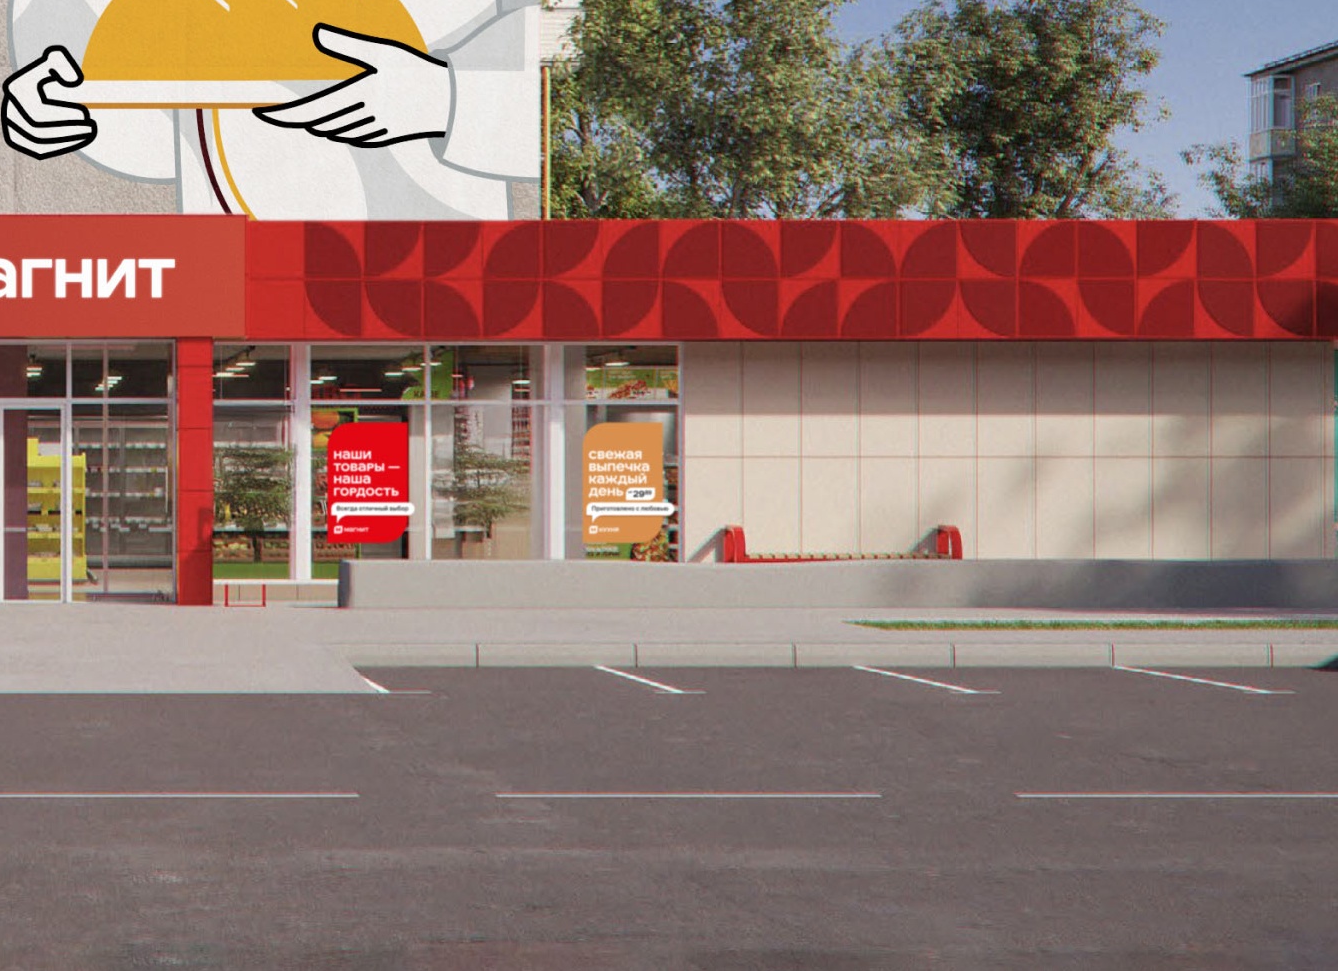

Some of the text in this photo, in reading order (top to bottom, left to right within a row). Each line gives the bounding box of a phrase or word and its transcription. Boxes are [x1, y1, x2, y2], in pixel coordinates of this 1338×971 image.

[333, 450, 372, 460] наши
[588, 450, 643, 460] свежая
[333, 462, 385, 472] товары
[588, 462, 650, 472] выпечка
[333, 474, 372, 484] наша
[588, 473, 647, 485] каждый
[333, 487, 400, 498] гордость
[588, 487, 624, 498] день
